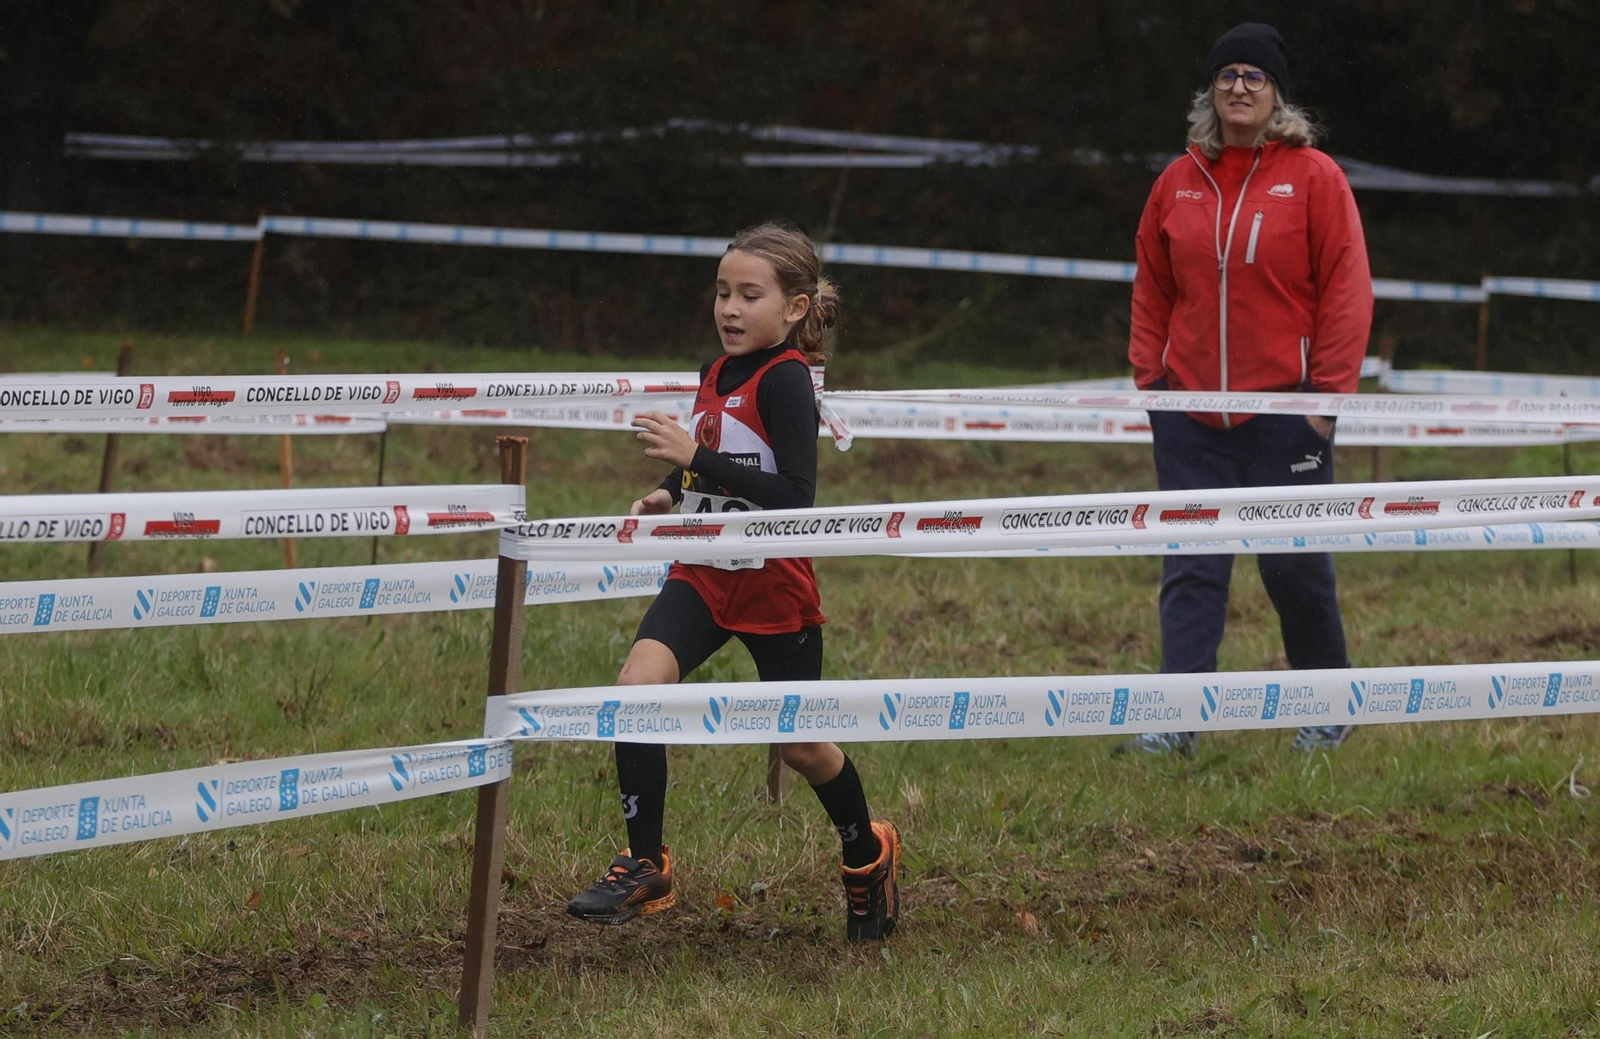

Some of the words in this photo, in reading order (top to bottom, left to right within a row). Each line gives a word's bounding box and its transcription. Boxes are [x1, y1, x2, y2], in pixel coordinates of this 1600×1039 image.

[0, 389, 70, 406] ONCELLO
[74, 389, 94, 405] DE
[100, 388, 134, 405] VIGO
[246, 387, 321, 402] CONCELLO
[324, 386, 343, 401] DE
[348, 386, 382, 400] VIGO
[486, 384, 556, 398] CONCELLO
[560, 383, 577, 396] DE
[583, 382, 614, 396] VIGO
[1456, 496, 1518, 513] CONCELLO
[1519, 495, 1536, 509] DE
[1539, 494, 1567, 509] VIGO
[1238, 504, 1301, 522] CONCELLO
[1305, 503, 1324, 518] DE
[1325, 502, 1355, 517] VIGO
[245, 513, 324, 535] CONCELLO
[331, 512, 349, 532] DE
[353, 511, 390, 531] VIGO
[1002, 510, 1071, 530] CONCELLO
[1075, 509, 1093, 526] DE
[1098, 509, 1128, 525] VIGO
[34, 520, 59, 538] DE
[64, 519, 103, 537] VIGO
[552, 523, 576, 539] DE
[577, 523, 616, 538] VIGO
[744, 519, 821, 537] CONCELLO
[825, 518, 845, 534] DE
[848, 517, 883, 533] VIGO
[534, 572, 566, 583] XUNTA
[625, 565, 662, 577] DEPORTE
[382, 579, 415, 592] XUNTA
[476, 575, 498, 586] DEPO
[618, 577, 652, 589] GALEGO
[223, 587, 258, 600] XUNTA
[321, 582, 362, 594] DEPORTE
[472, 588, 497, 600] GALE
[529, 585, 542, 596] DE
[544, 583, 580, 594] GALICIA
[0, 597, 35, 609] EPORTE
[58, 595, 94, 608] XUNTA
[161, 590, 202, 602] DEPORTE
[317, 597, 355, 609] GALEGO
[377, 594, 391, 605] DE
[393, 592, 431, 604] GALICIA
[157, 605, 195, 618] GALEGO
[219, 602, 233, 614] DE
[236, 600, 276, 613] GALICIA
[0, 613, 29, 625] LEGO
[54, 610, 70, 623] DE
[72, 608, 113, 621] GALICIA
[1426, 680, 1457, 694] XUNTA
[1511, 676, 1547, 690] DEPORTE
[1563, 675, 1592, 688] XUNTA
[1225, 687, 1264, 701] DEPORTE
[1282, 686, 1315, 699] XUNTA
[1372, 683, 1408, 696] DEPORTE
[1559, 690, 1571, 704] DE
[1573, 689, 1600, 703] GALIC
[802, 698, 840, 711] XUNTA
[908, 695, 950, 709] DEPORTE
[972, 694, 1007, 709] XUNTA
[1071, 691, 1112, 706] DEPORTE
[1131, 690, 1165, 705] XUNTA
[1422, 697, 1434, 710] DE
[1436, 695, 1471, 709] GALICIA
[1508, 693, 1540, 706] GALEGO
[547, 704, 599, 719] DEPORTE
[618, 702, 663, 715] XUNTA
[734, 699, 781, 712] DEPORTE
[1222, 705, 1258, 719] GALEGO
[1278, 703, 1290, 716] DE
[1293, 701, 1330, 715] GALICIA
[1368, 699, 1403, 713] GALEGO
[904, 713, 943, 727] GALEGO
[968, 712, 982, 726] DE
[984, 710, 1025, 726] GALICIA
[1068, 710, 1105, 724] GALEGO
[1128, 708, 1141, 722] DE
[1143, 706, 1182, 721] GALICIA
[618, 719, 633, 734] DE
[636, 717, 682, 733] GALICIA
[730, 716, 772, 730] GALEGO
[798, 715, 812, 729] DE
[815, 714, 859, 729] GALICIA
[548, 721, 590, 738] GALEGO
[489, 754, 505, 771] DE
[302, 766, 344, 785] XUNTA
[419, 764, 462, 785] GALEGO
[226, 775, 277, 796] DEPORTE
[302, 788, 319, 805] DE
[321, 781, 370, 802] GALICIA
[102, 795, 146, 813] XUNTA
[226, 796, 273, 816] GALEGO
[22, 803, 76, 824] DEPORTE
[101, 817, 117, 834] DE
[122, 809, 173, 831] GALICIA
[21, 825, 69, 845] GALEGO
